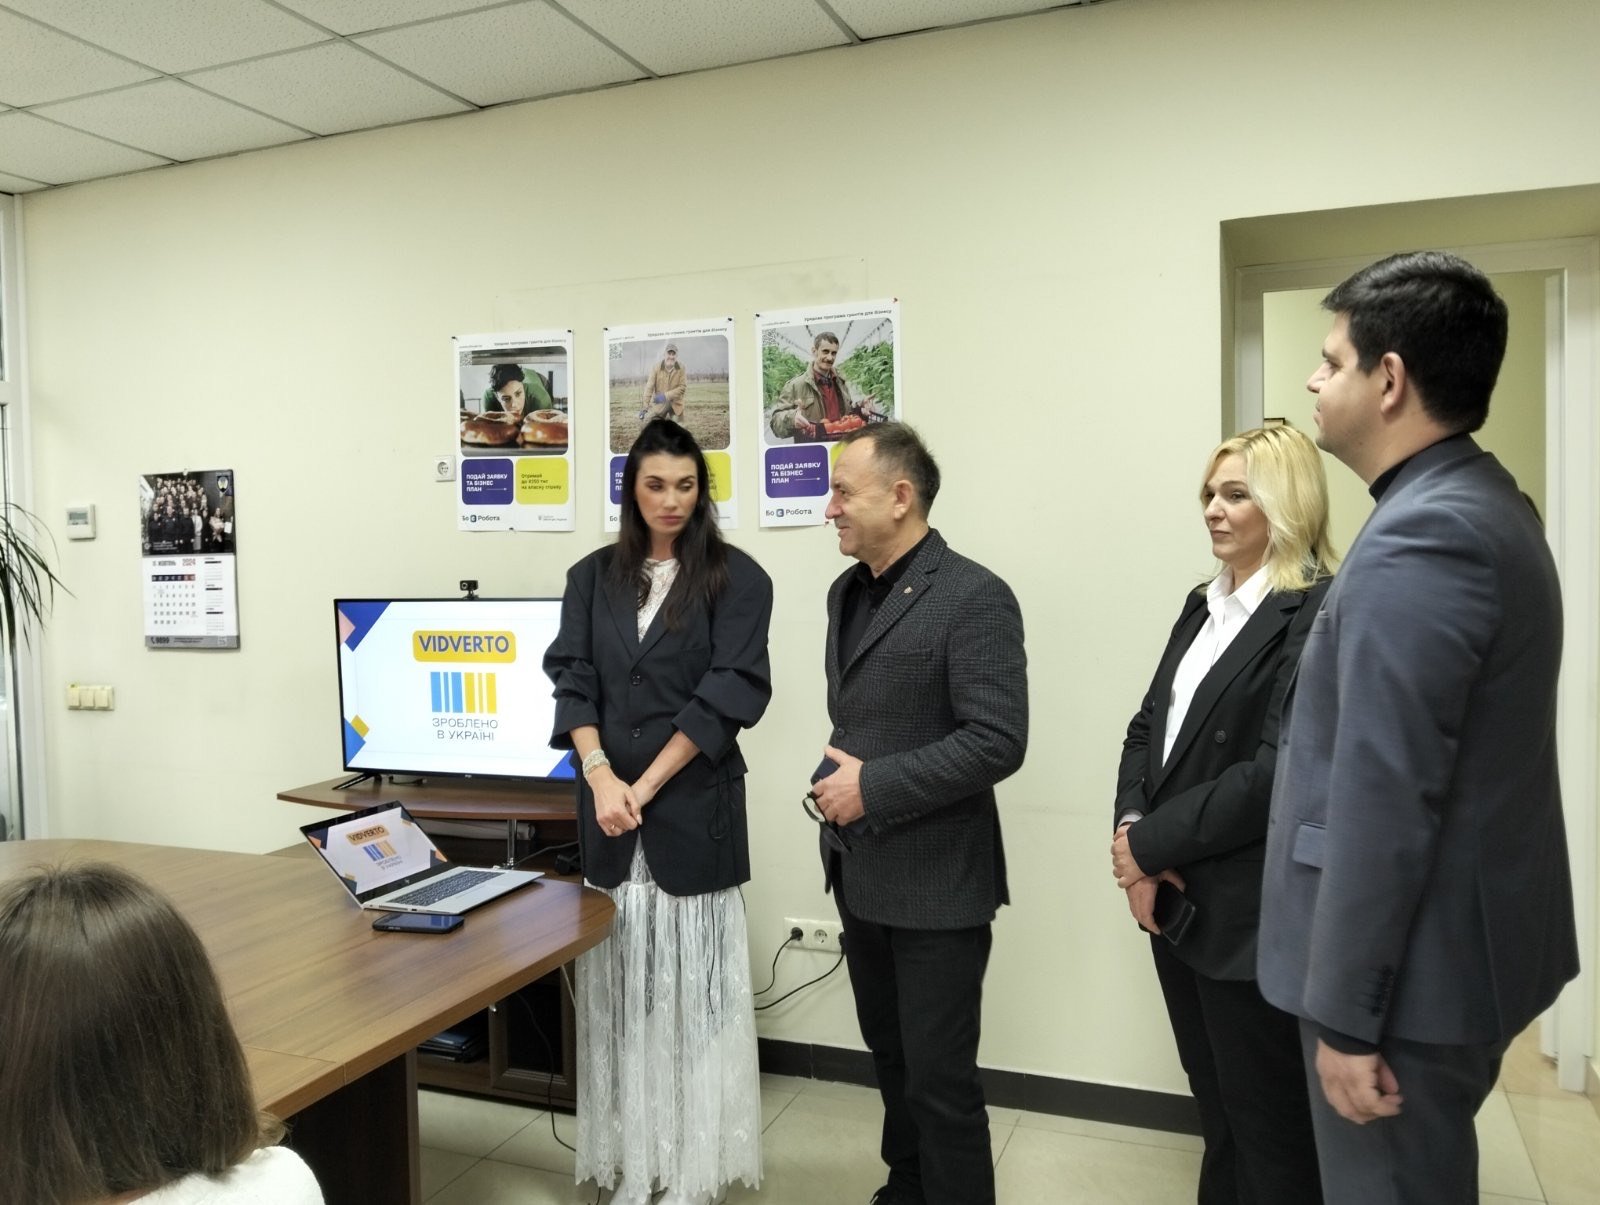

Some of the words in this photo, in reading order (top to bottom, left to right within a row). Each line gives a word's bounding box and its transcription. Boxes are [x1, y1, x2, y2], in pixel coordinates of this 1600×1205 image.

[418, 635, 509, 653] VIDVERTO
[432, 718, 498, 729] ЗРОБЛЕНО
[437, 730, 445, 739] В
[448, 729, 494, 741] УКРАЇНІ
[348, 826, 385, 841] VIDVERTO
